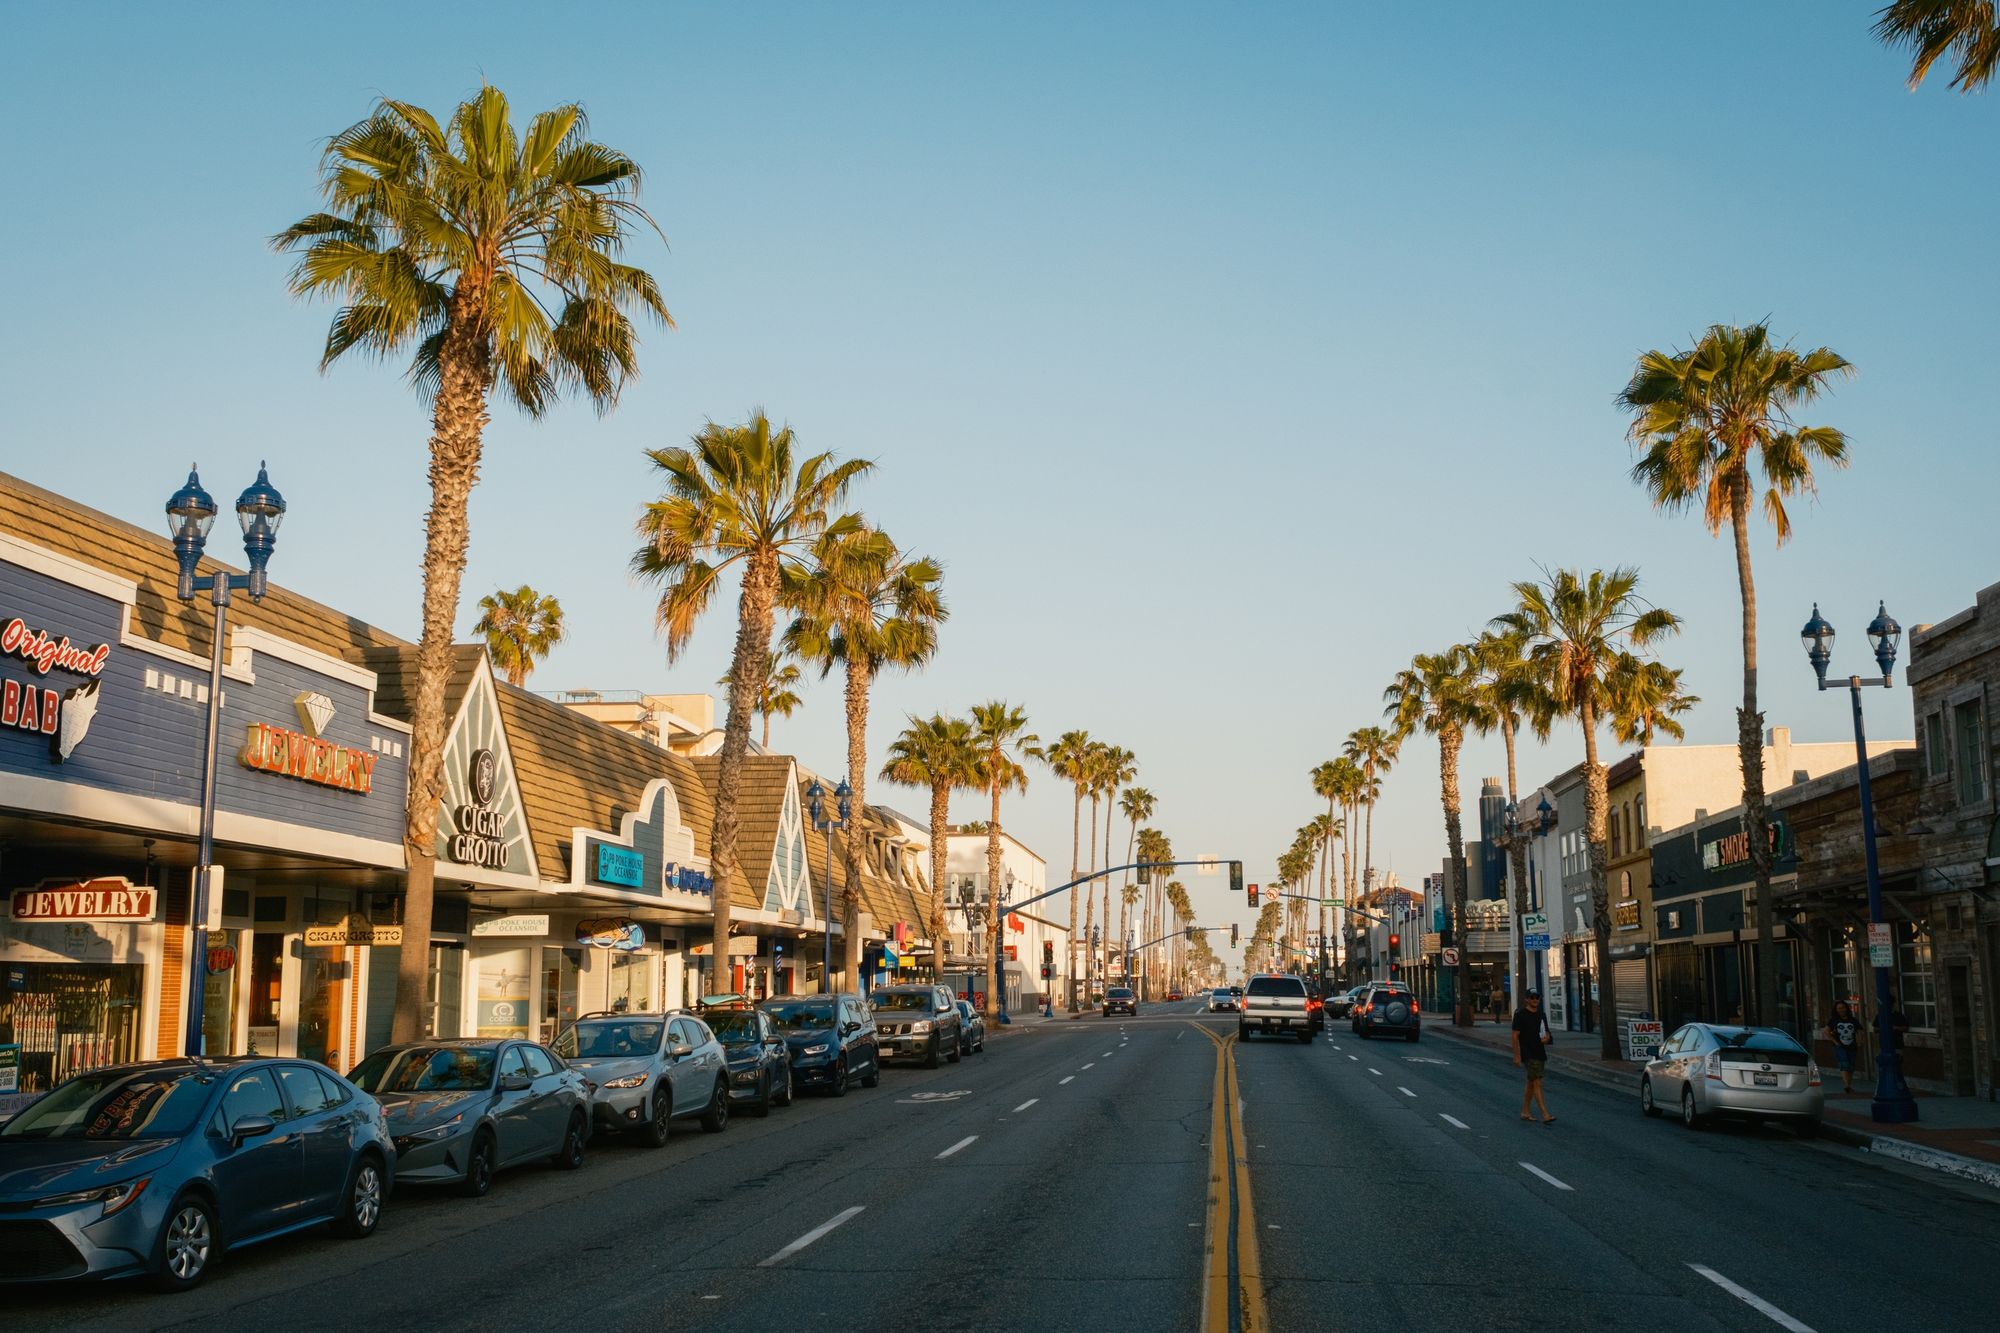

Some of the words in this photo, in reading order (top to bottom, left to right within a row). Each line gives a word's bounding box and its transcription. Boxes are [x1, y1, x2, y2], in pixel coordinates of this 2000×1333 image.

[1, 618, 110, 676] Original
[0, 678, 59, 735] BAB
[245, 722, 379, 794] JEWELRY
[461, 805, 505, 839] CIGAR
[455, 832, 510, 869] GROTTO
[1720, 831, 1750, 866] SMOKE
[615, 866, 637, 880] OCEANSIDE
[628, 859, 642, 870] HOUSE
[17, 891, 146, 917] JEWELRY
[308, 931, 346, 942] CIGAR
[350, 930, 400, 942] GROTTO
[207, 948, 235, 972] OPEN
[1631, 1036, 1650, 1045] CBD
[1634, 1023, 1661, 1033] VAPE
